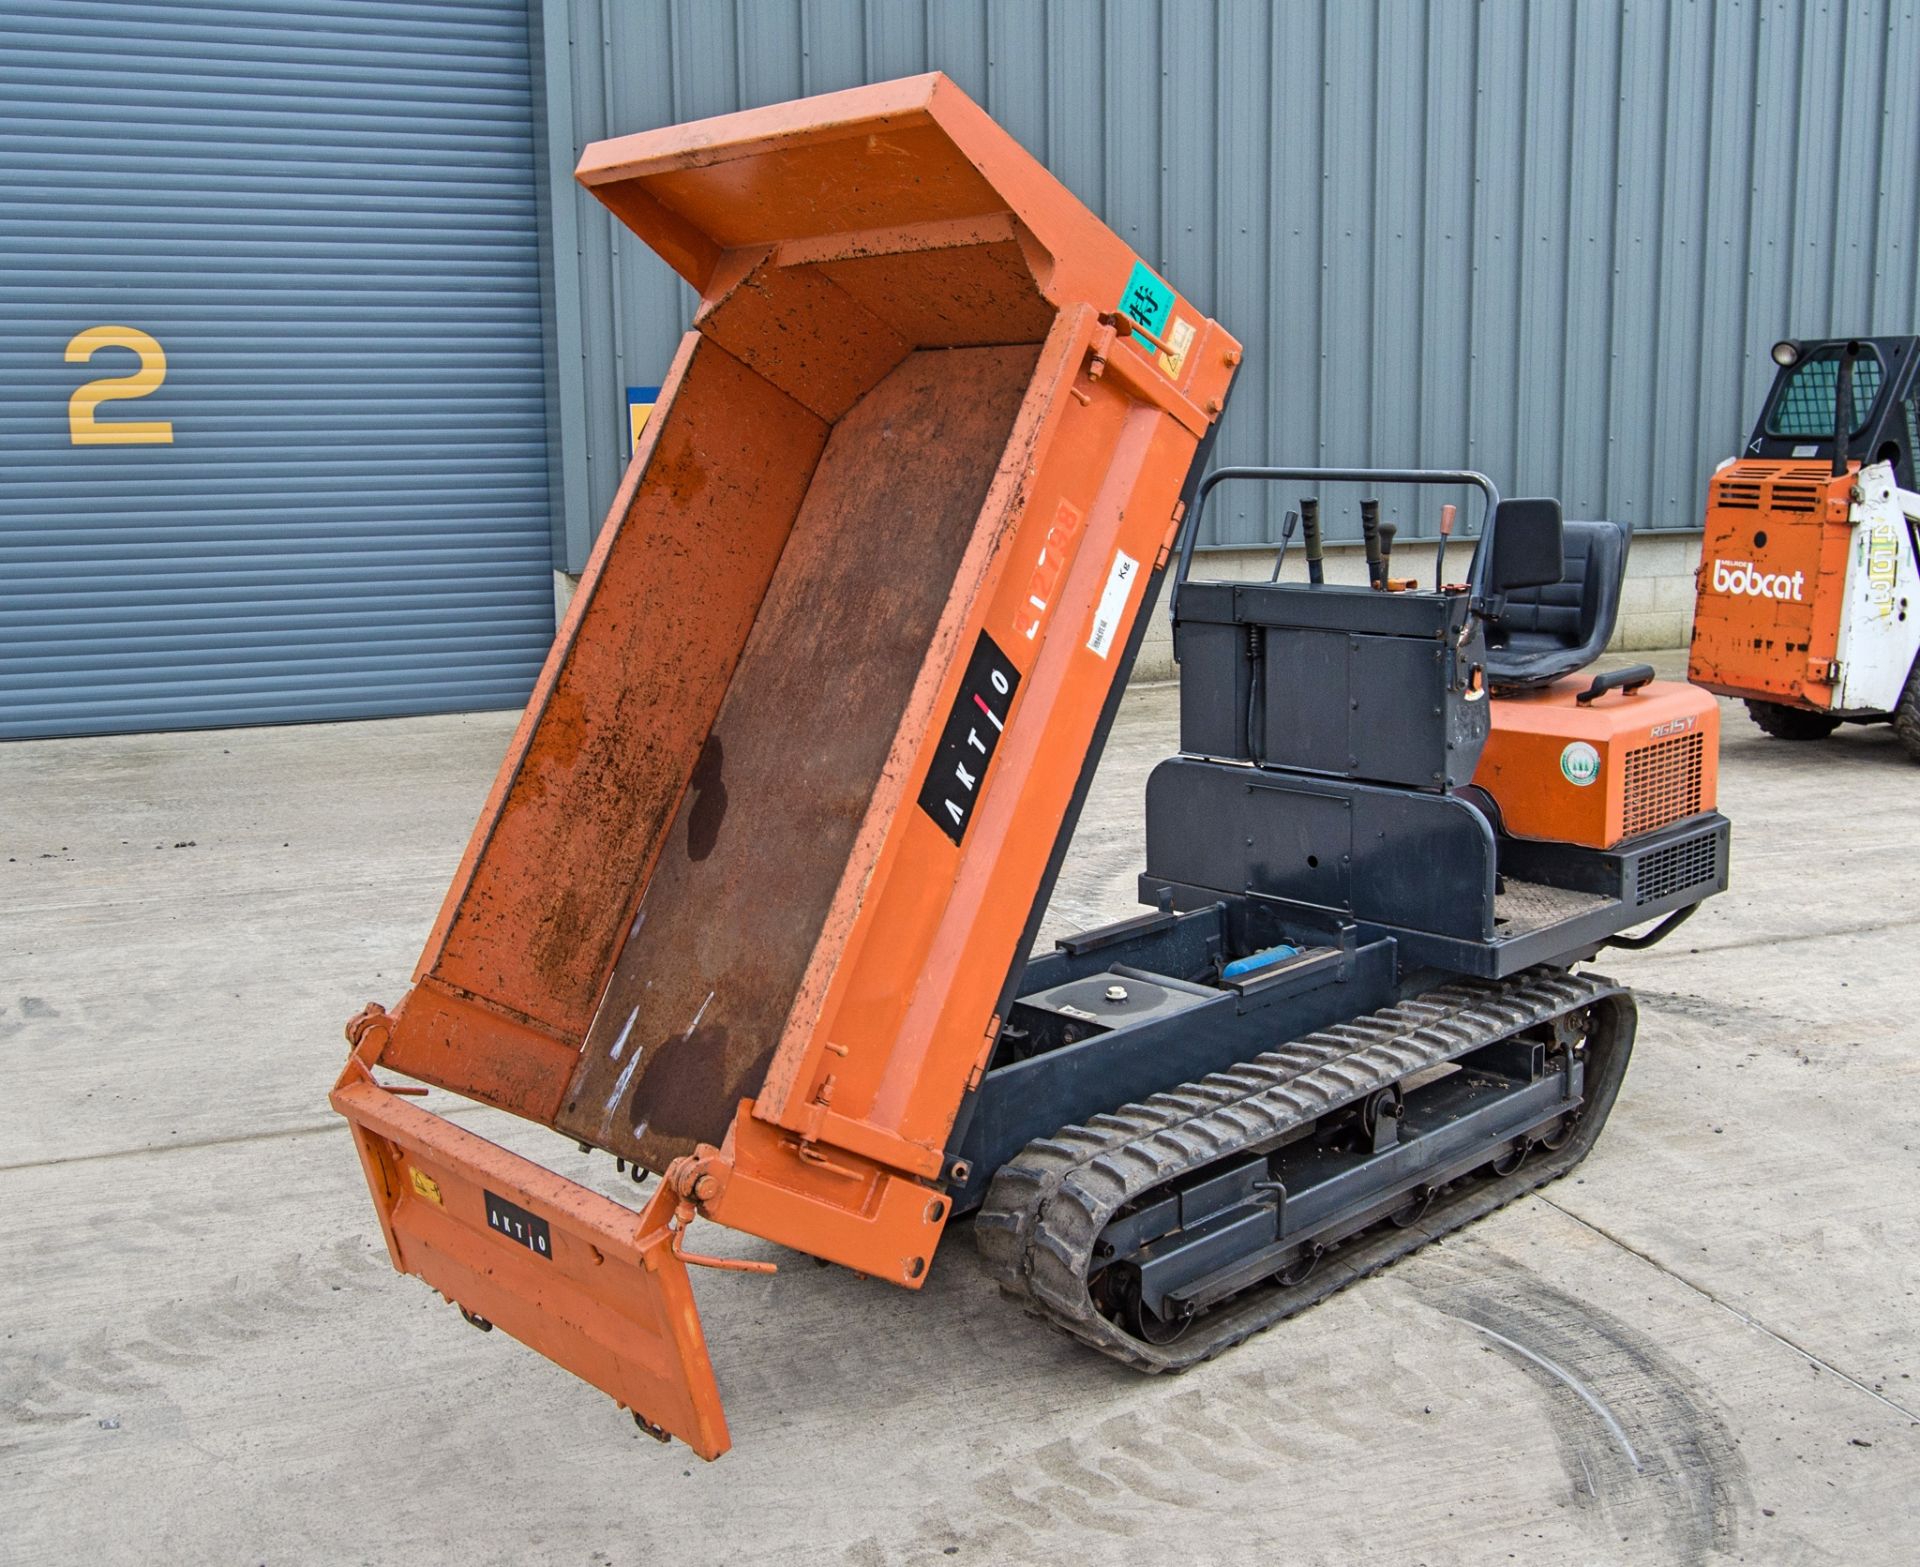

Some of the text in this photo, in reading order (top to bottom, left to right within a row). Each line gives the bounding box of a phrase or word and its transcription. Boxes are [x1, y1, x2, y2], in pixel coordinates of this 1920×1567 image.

[1129, 285, 1159, 327] 特
[64, 325, 174, 445] 2
[1118, 562, 1131, 579] Kg
[1713, 559, 1804, 601] bobcat
[1870, 524, 1895, 604] 453
[944, 669, 1008, 826] AKTIO
[492, 1210, 546, 1251] AKTIO
